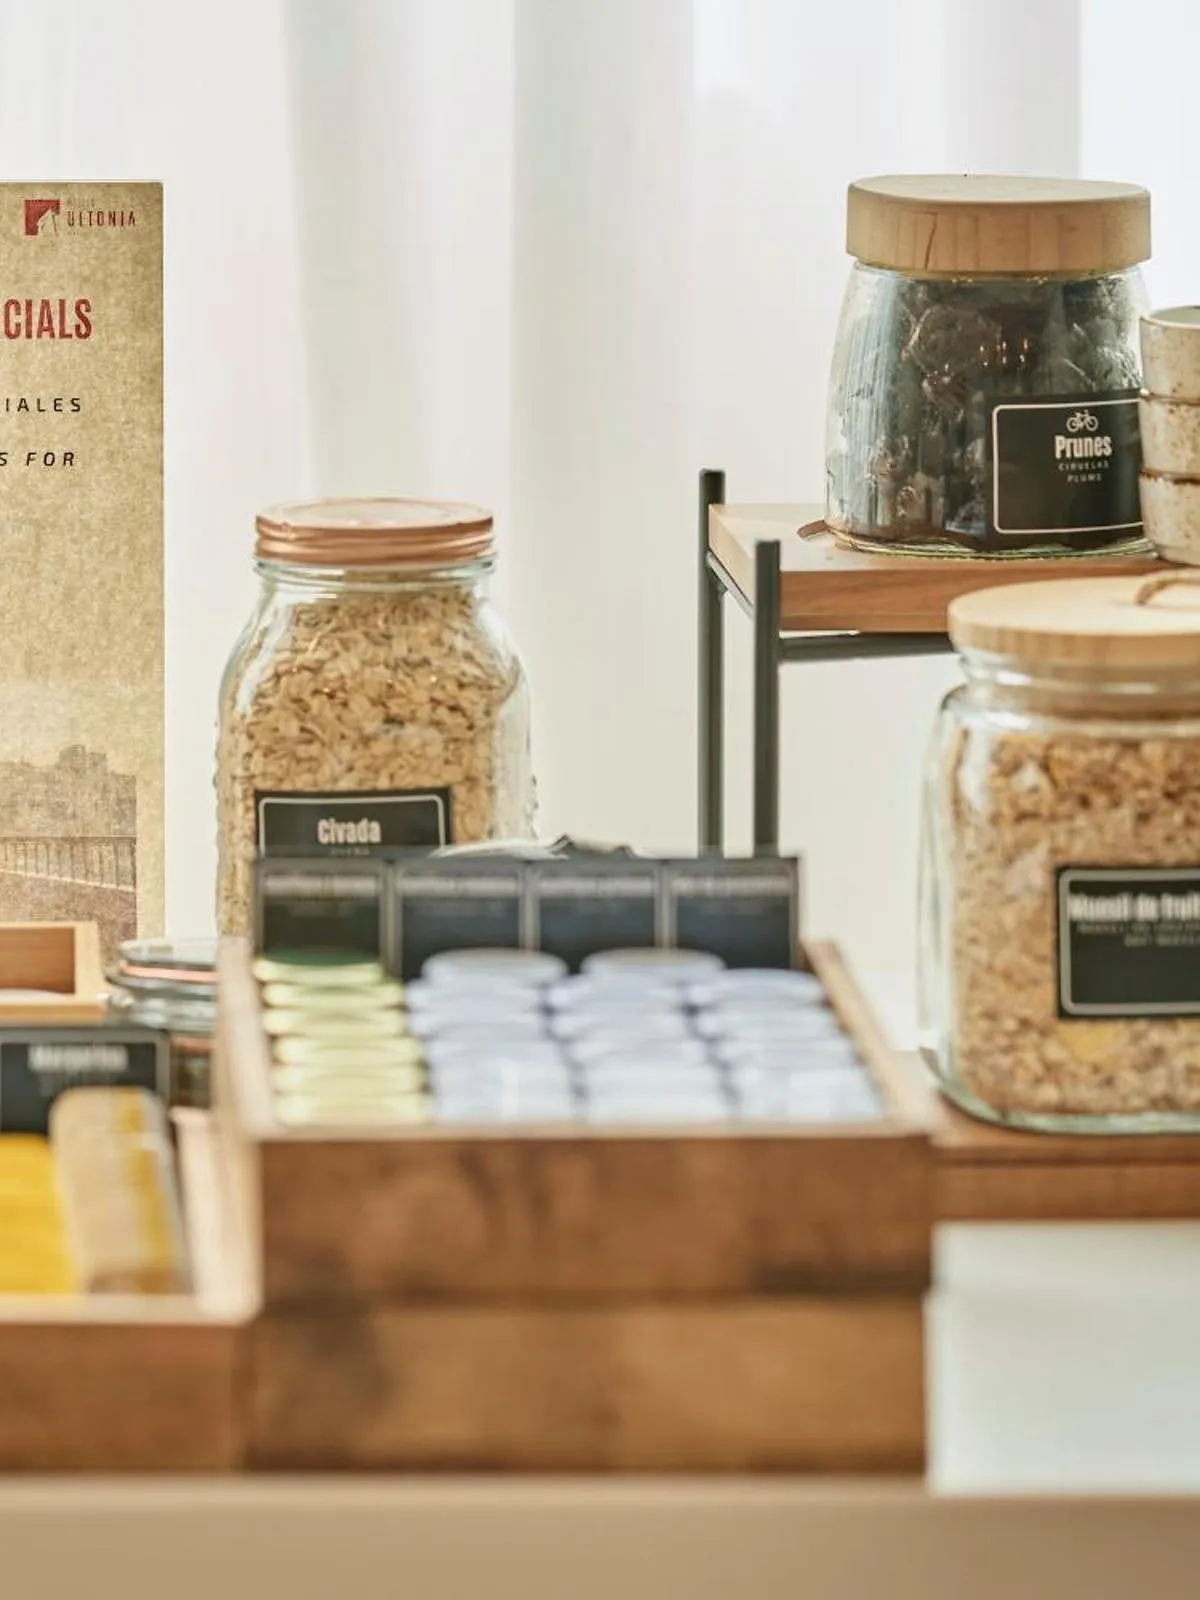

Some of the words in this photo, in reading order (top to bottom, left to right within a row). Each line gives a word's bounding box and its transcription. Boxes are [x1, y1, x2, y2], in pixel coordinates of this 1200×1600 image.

[67, 210, 136, 227] ULTONIA
[1054, 433, 1112, 458] Prunes
[25, 451, 76, 467] FOR
[317, 817, 382, 845] Civada
